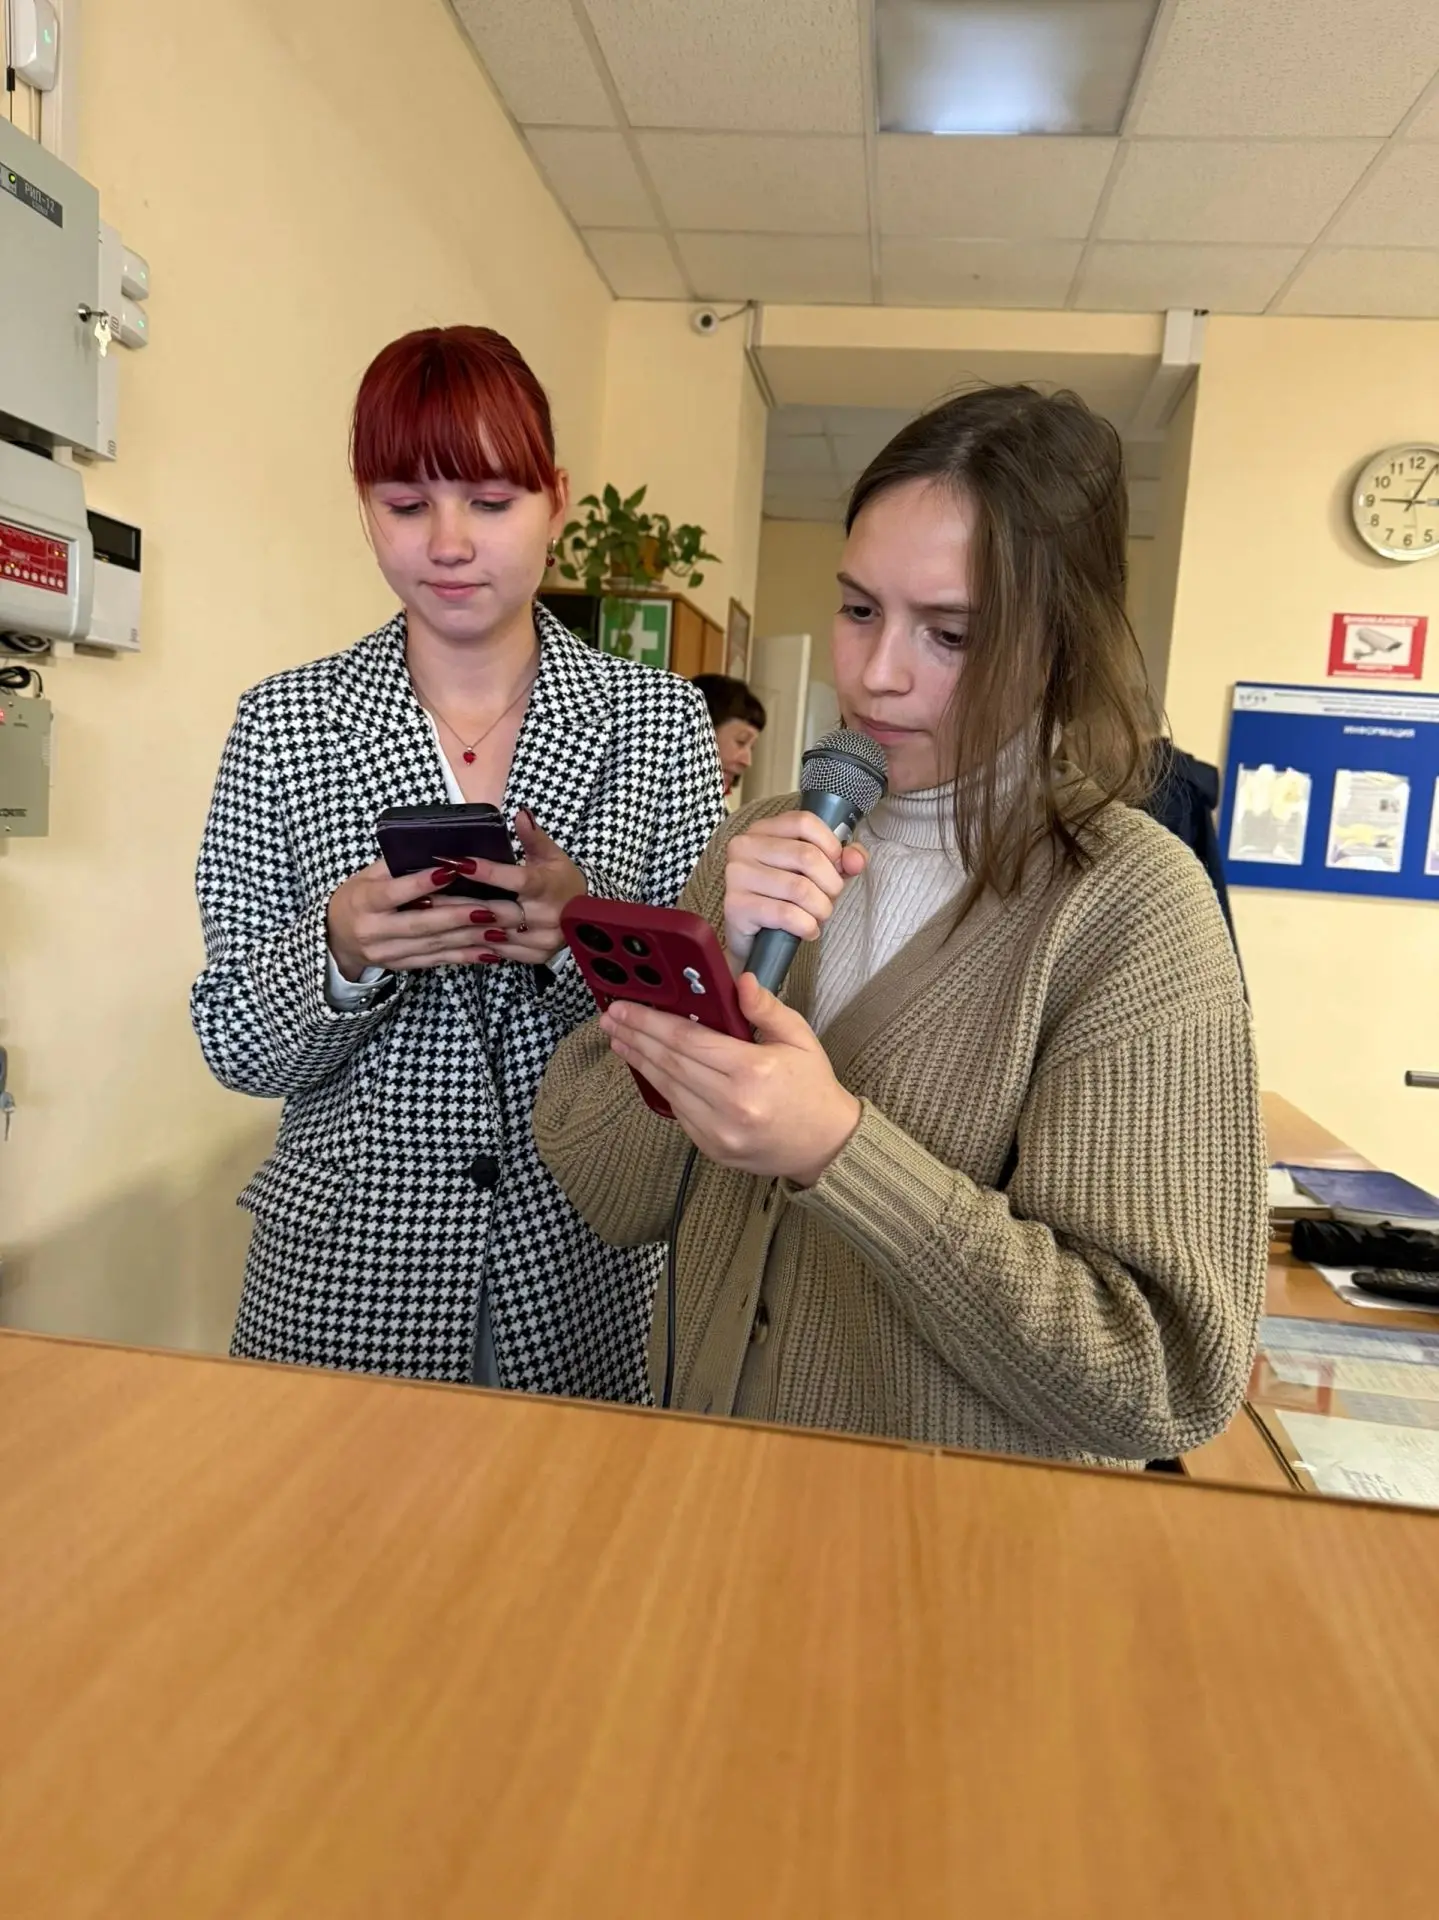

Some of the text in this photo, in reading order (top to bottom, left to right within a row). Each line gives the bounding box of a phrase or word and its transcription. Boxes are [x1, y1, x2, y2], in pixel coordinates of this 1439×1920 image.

[1391, 462, 1404, 475] 11
[1410, 456, 1426, 470] 12
[1374, 476, 1391, 488] 10
[1365, 494, 1375, 507] 9
[1370, 513, 1380, 527] 8
[1385, 528, 1394, 541] 7
[1403, 533, 1413, 547] 6
[1424, 529, 1433, 542] 5
